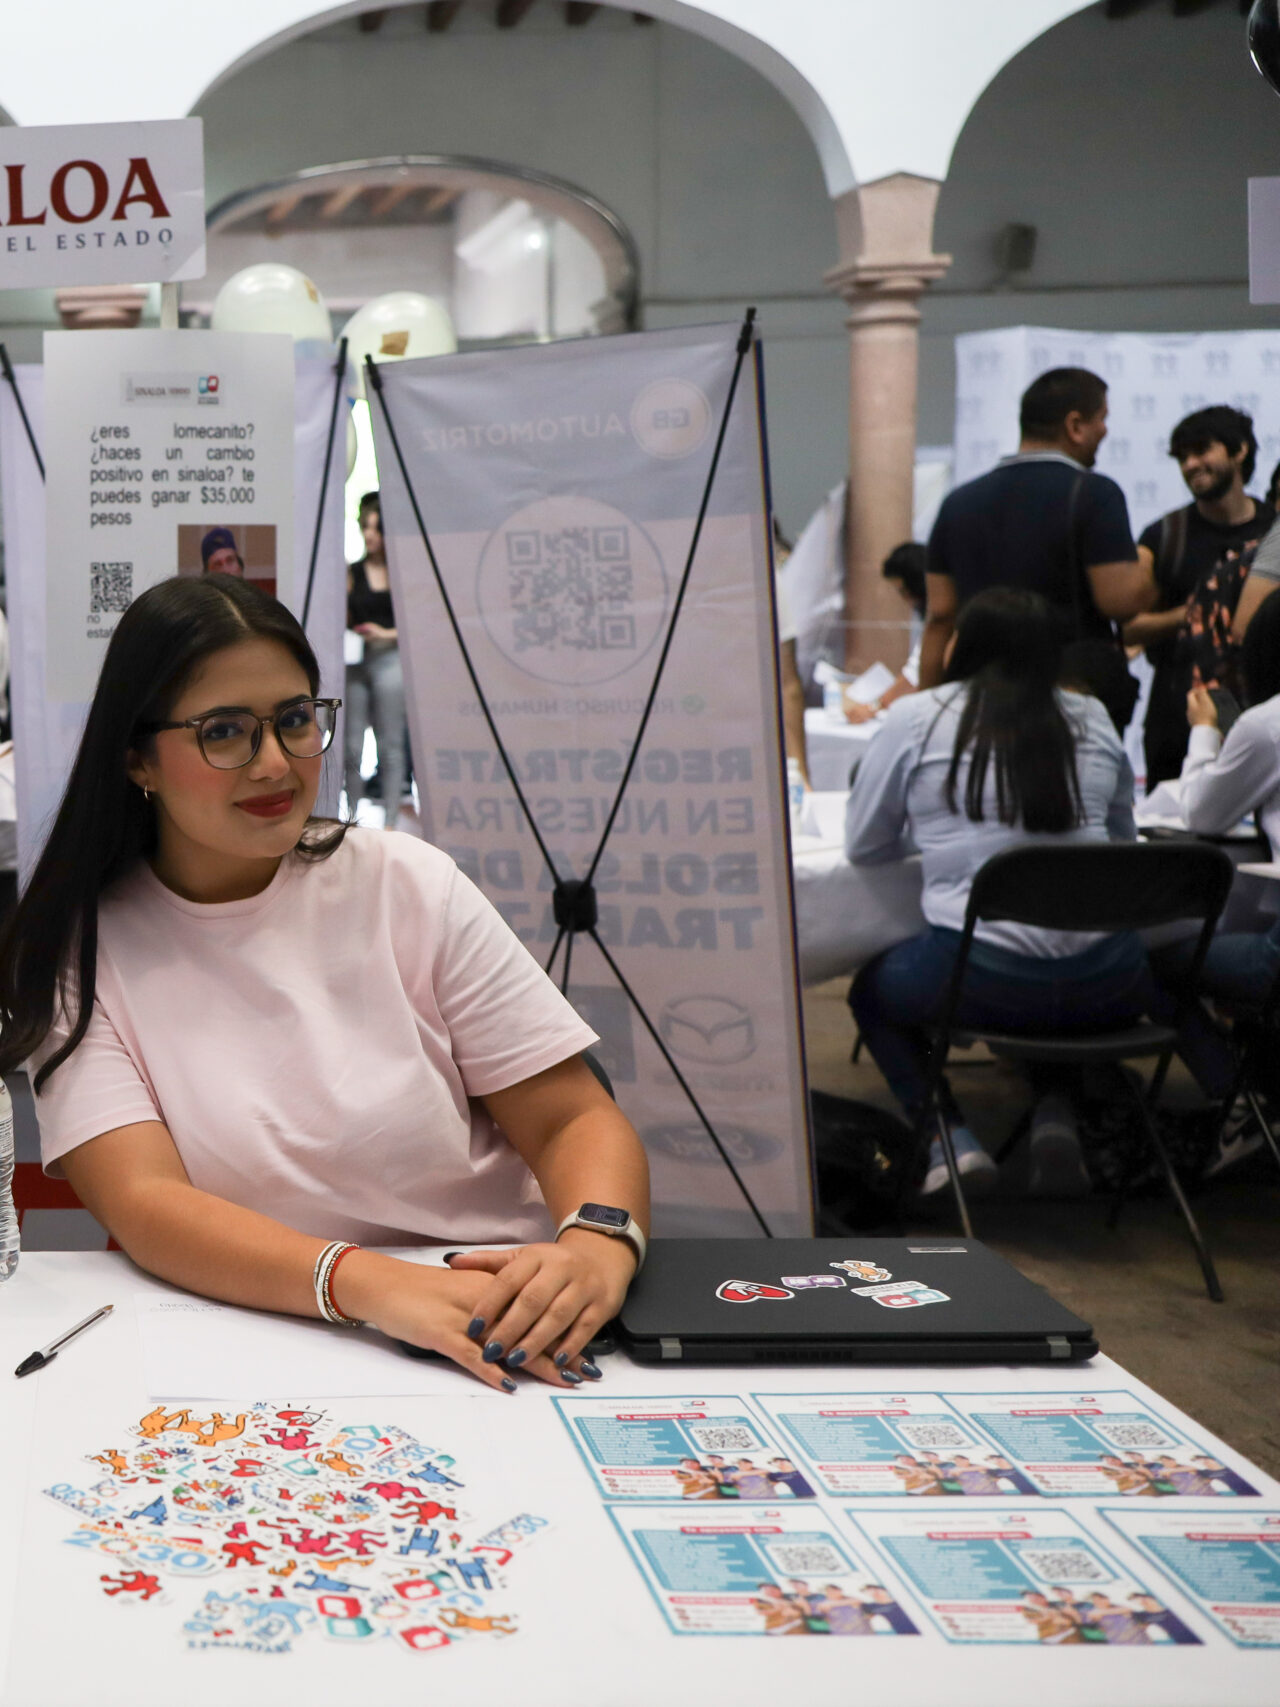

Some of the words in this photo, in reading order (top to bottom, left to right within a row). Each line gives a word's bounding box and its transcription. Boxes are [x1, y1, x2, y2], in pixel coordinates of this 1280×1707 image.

[57, 229, 173, 250] ESTADO
[90, 424, 130, 443] ¿eres
[173, 422, 255, 440] lomecanito?
[90, 445, 141, 464] ¿haces
[166, 448, 183, 460] un
[207, 445, 255, 460] cambio
[90, 467, 143, 485] positivo
[152, 471, 169, 482] en
[178, 466, 234, 482] sinaloa?
[242, 468, 255, 482] te
[90, 488, 142, 507] puedes
[152, 491, 191, 507] ganar
[201, 486, 255, 505] $35,000
[90, 512, 132, 529] pesos
